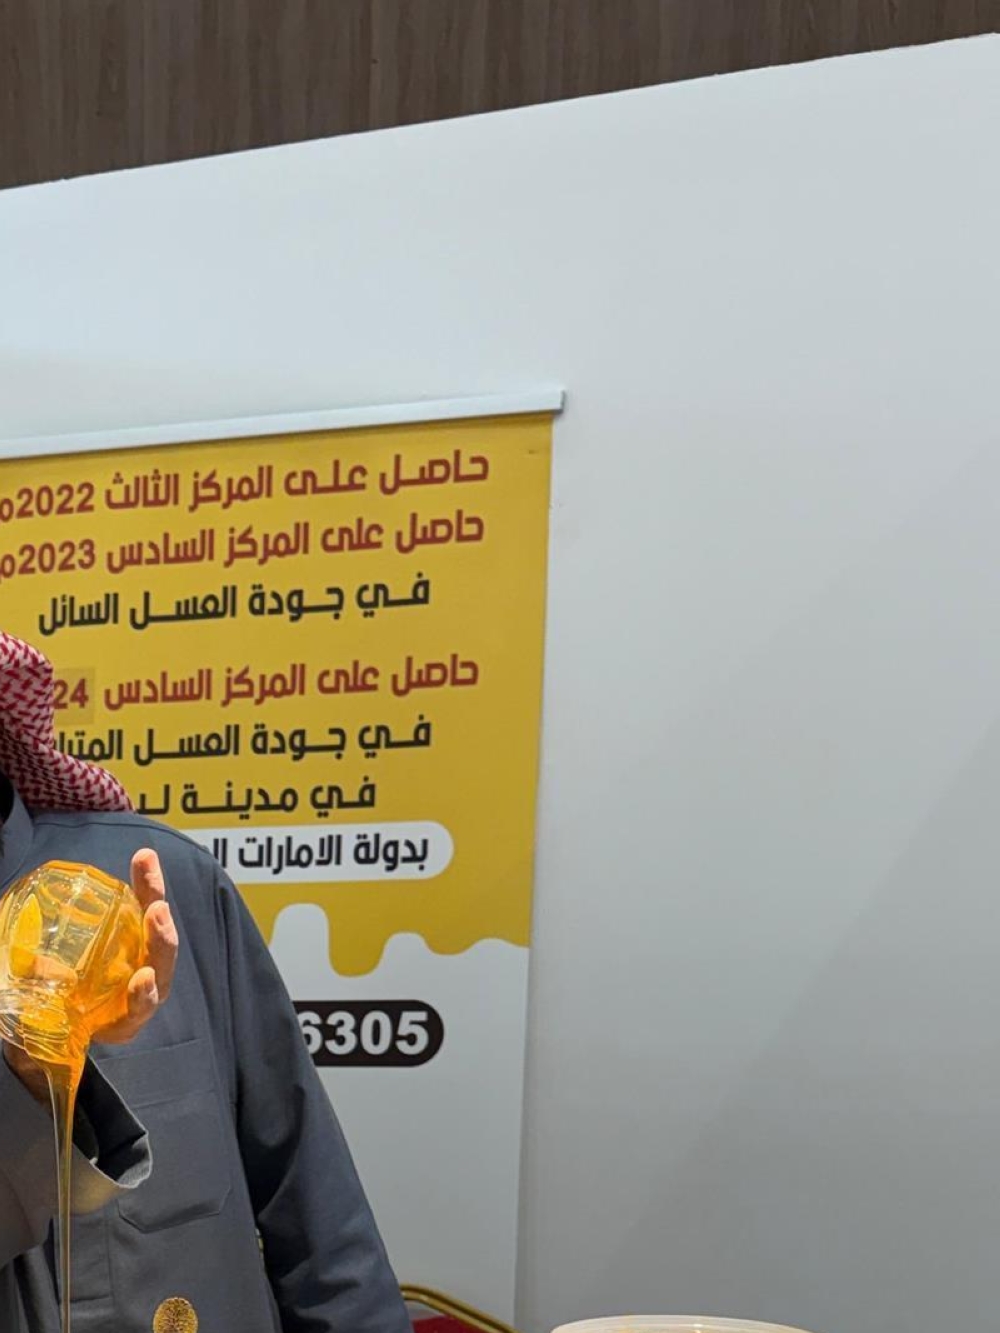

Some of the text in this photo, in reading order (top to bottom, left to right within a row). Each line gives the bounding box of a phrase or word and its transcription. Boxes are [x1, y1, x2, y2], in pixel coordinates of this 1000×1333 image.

[104, 468, 180, 512] الثالث
[189, 465, 273, 513] المركز
[284, 459, 368, 496] على
[379, 449, 490, 496] حاصل
[106, 528, 215, 576] السادس
[224, 522, 310, 569] المركز
[321, 516, 385, 555] على
[395, 508, 486, 555] حاصل
[38, 572, 431, 636] في جودة العسل السائل
[53, 653, 480, 711] حاصل على المركز السادس 24
[133, 724, 240, 767] العسل
[250, 723, 347, 767] جودة
[357, 714, 432, 762] في
[181, 780, 298, 820] مدينة
[310, 776, 376, 817] في
[238, 834, 343, 875] الامارات
[353, 833, 428, 871] بدولة
[300, 1010, 430, 1056] 6305
